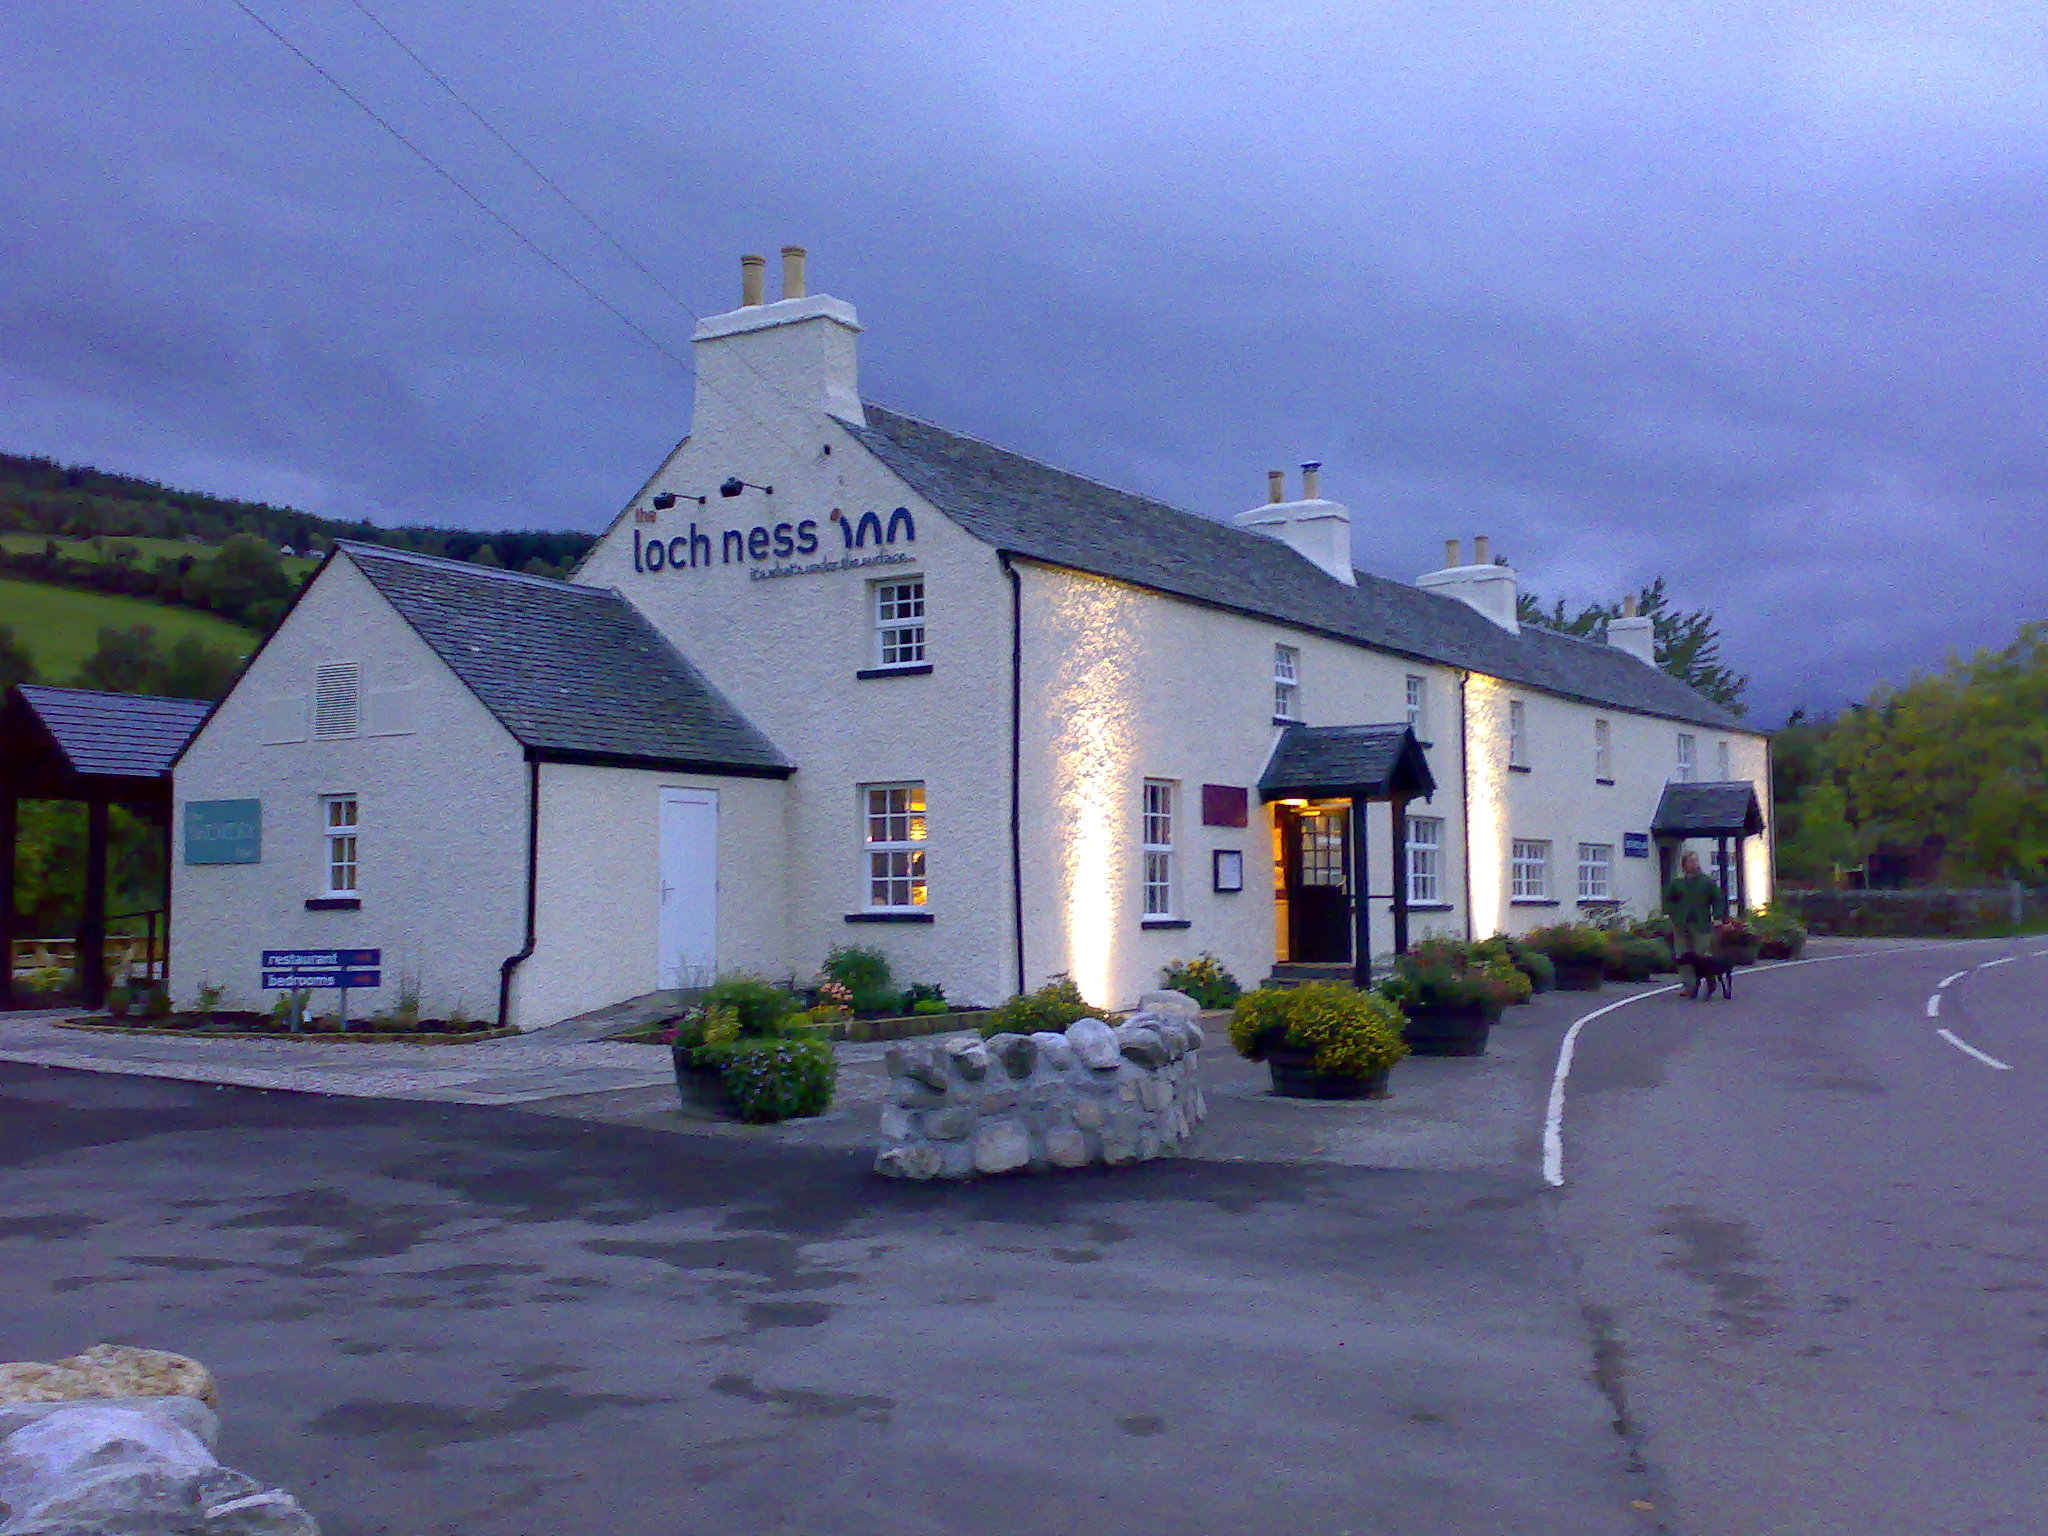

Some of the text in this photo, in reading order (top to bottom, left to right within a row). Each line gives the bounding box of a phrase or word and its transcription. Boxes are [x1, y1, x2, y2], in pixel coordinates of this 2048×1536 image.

[636, 508, 657, 523] the
[633, 507, 915, 573] loch ness inn
[267, 952, 338, 965] restaurant
[267, 974, 336, 985] bedrooms
